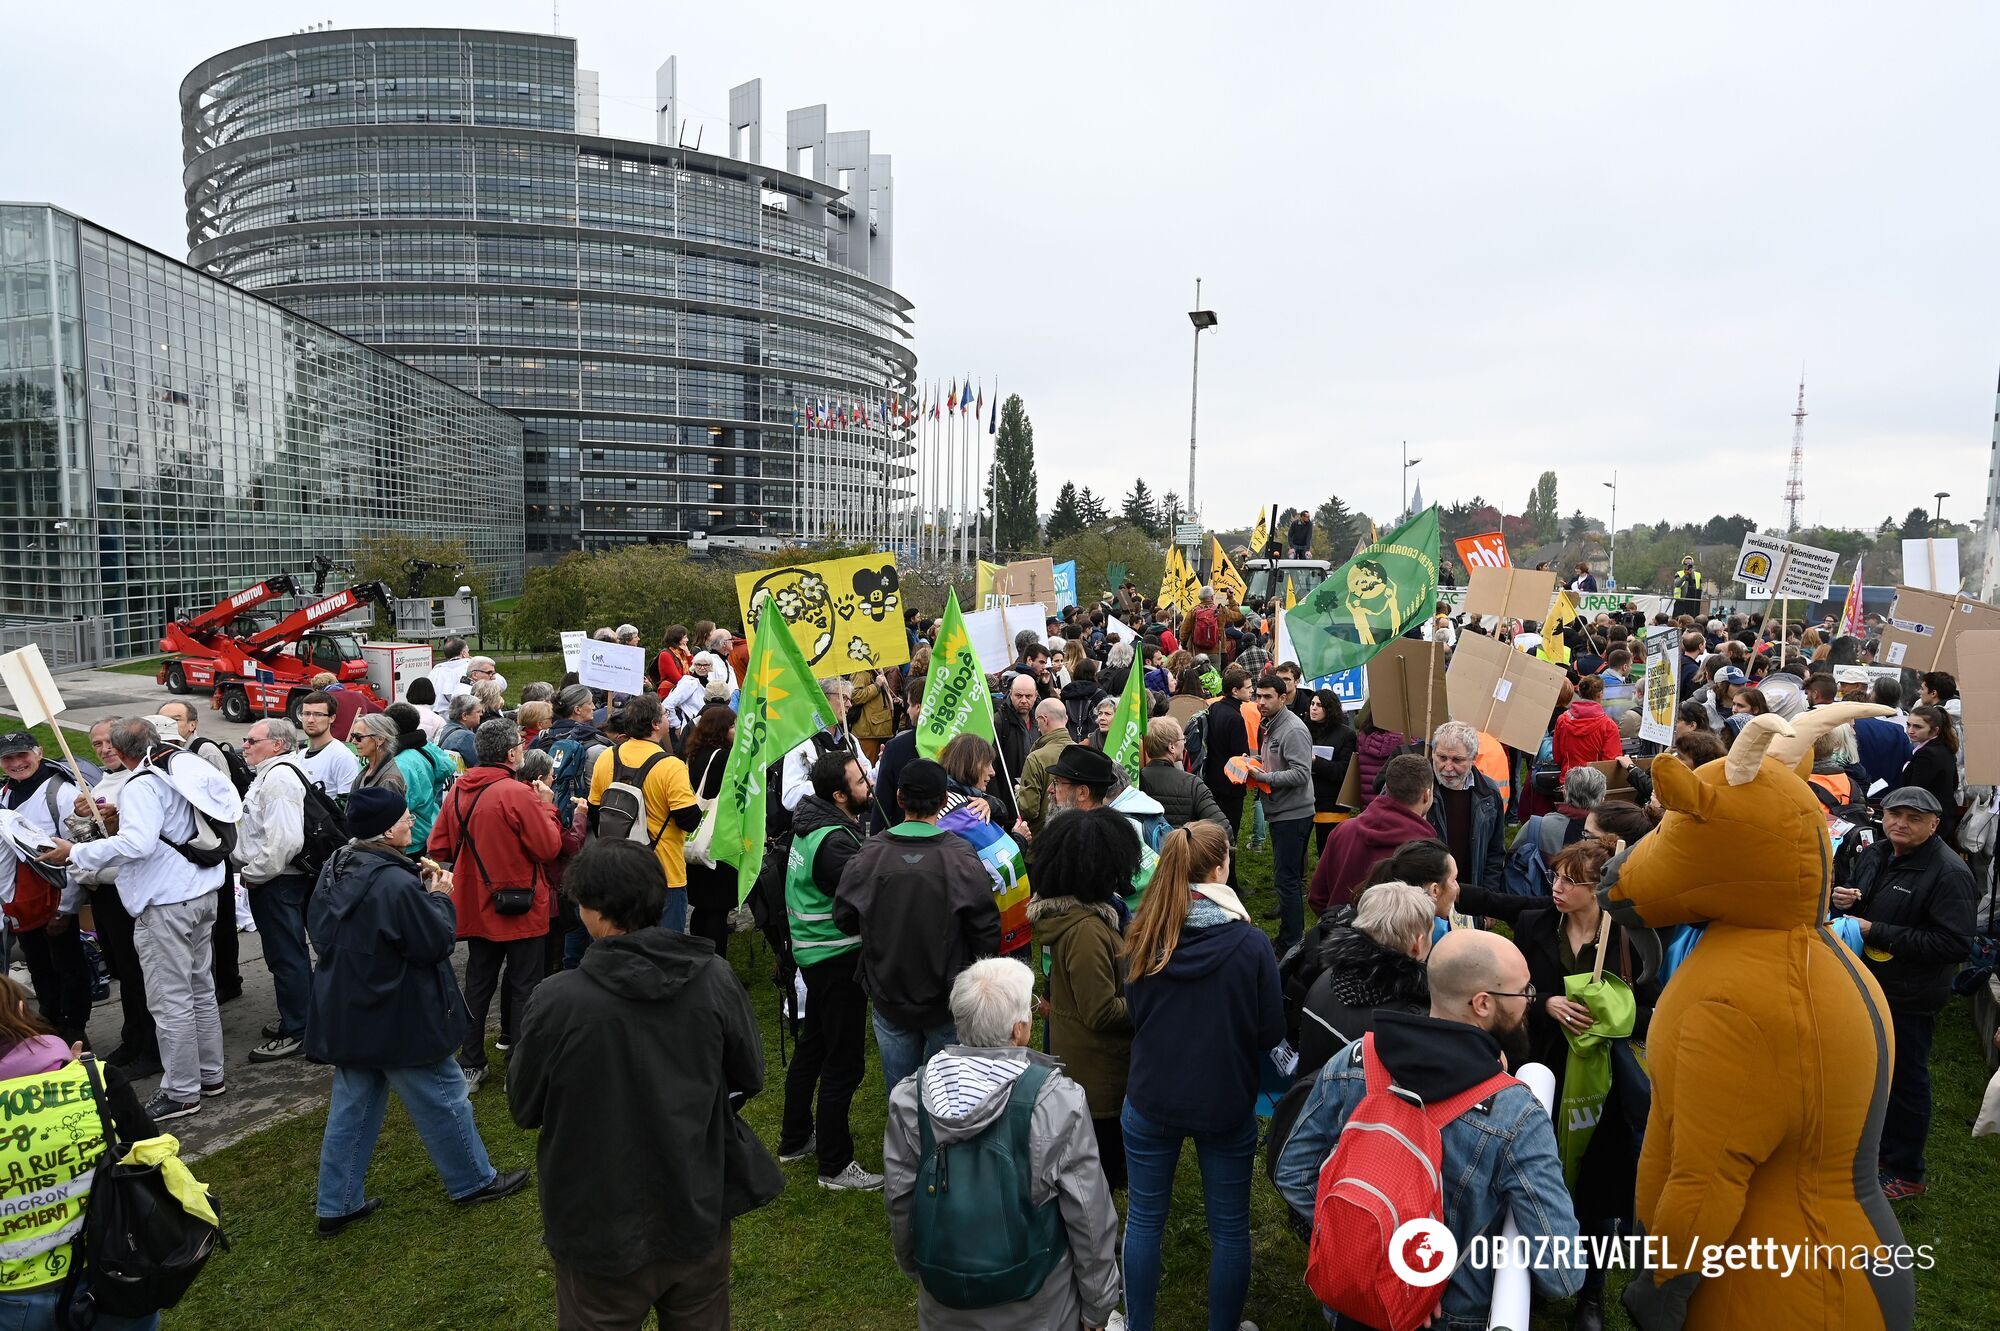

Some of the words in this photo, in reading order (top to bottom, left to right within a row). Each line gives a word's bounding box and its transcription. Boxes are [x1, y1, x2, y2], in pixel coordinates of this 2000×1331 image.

[1748, 538, 1779, 552] verlässlich
[1780, 544, 1834, 564] fuktionierender
[1791, 558, 1830, 573] Bienenschutz
[1797, 568, 1808, 576] was
[1809, 570, 1829, 580] anders
[231, 586, 263, 608] MANITOU
[1791, 587, 1807, 596] wach
[306, 592, 347, 621] MANITOU
[1578, 594, 1634, 611] URABLE
[1866, 670, 1899, 678] ktionierender
[256, 695, 280, 703] MAITOU
[28, 1145, 76, 1175] RUE
[0, 1186, 69, 1216] ACRON
